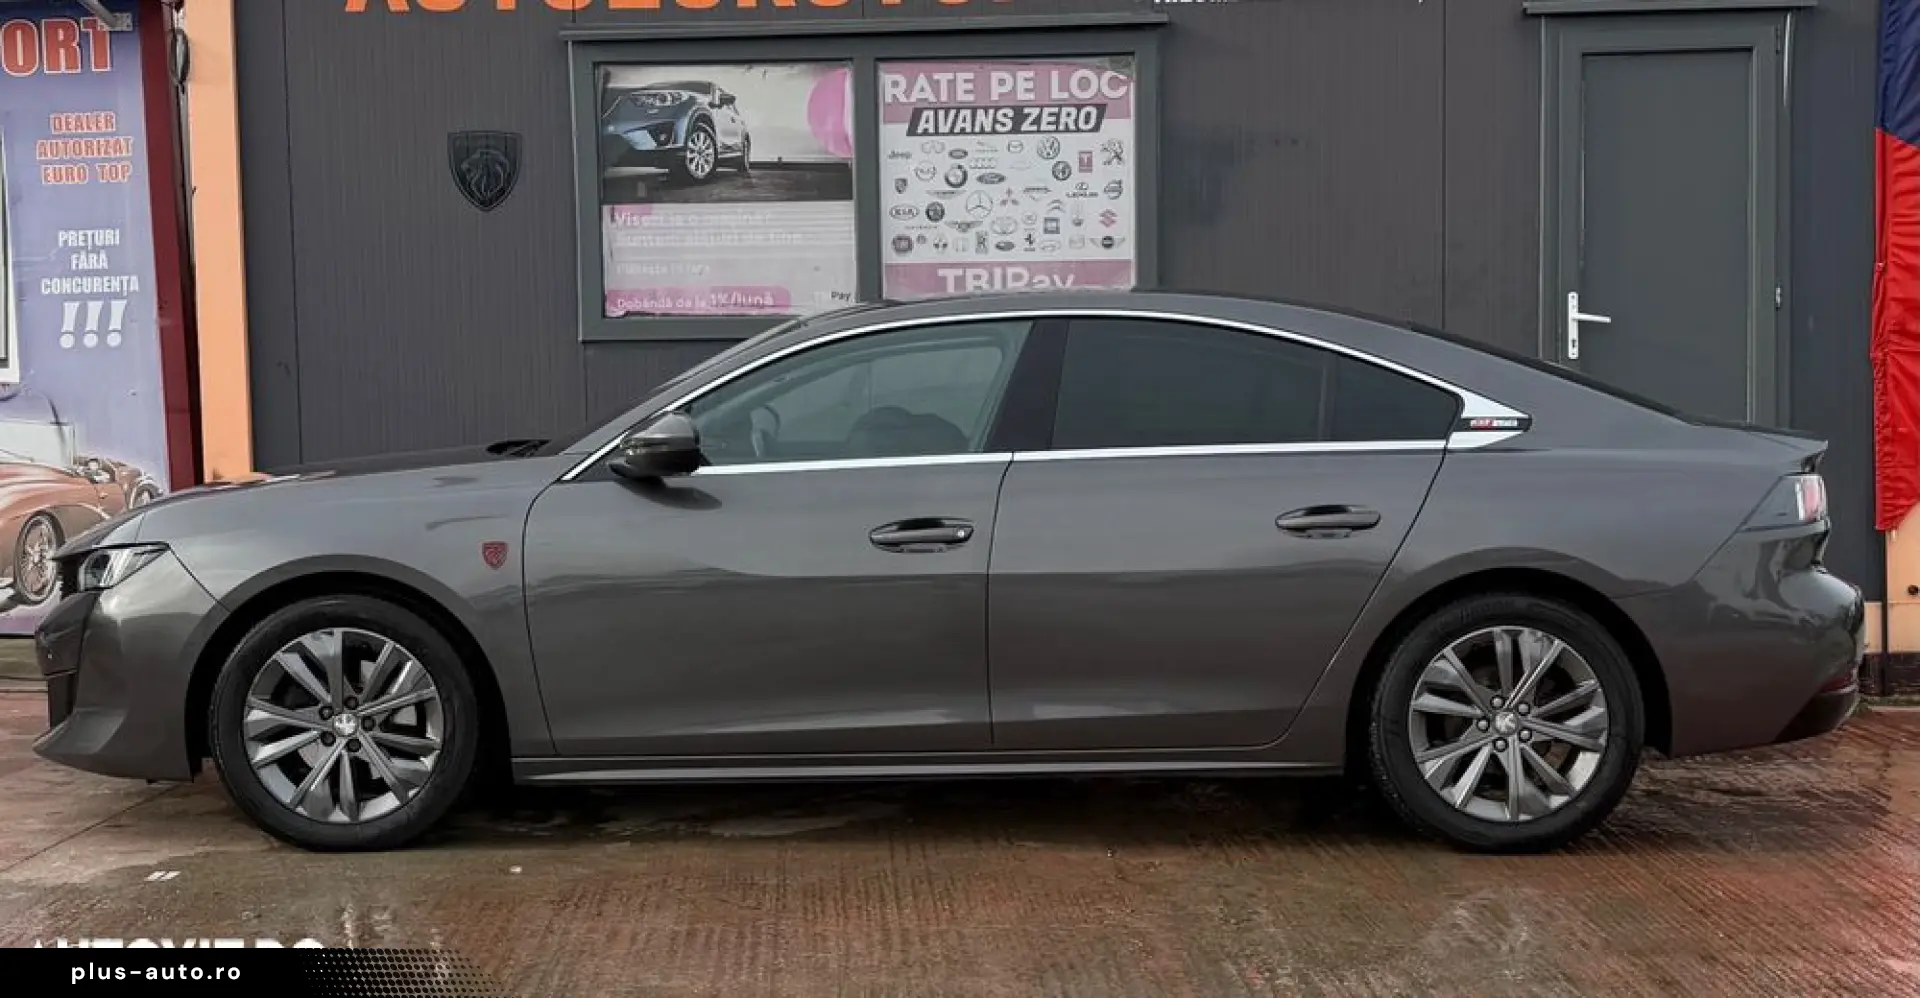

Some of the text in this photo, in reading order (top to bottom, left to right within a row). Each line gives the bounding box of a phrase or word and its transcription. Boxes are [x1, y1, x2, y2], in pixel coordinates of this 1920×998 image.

[884, 69, 1128, 103] RATE PE LOC
[52, 111, 116, 134] DEALER
[917, 106, 1097, 134] AVANS ZERO
[36, 136, 134, 160] AUTORIZAT
[42, 161, 132, 184] EURO TOP
[58, 228, 120, 249] PREȚURI
